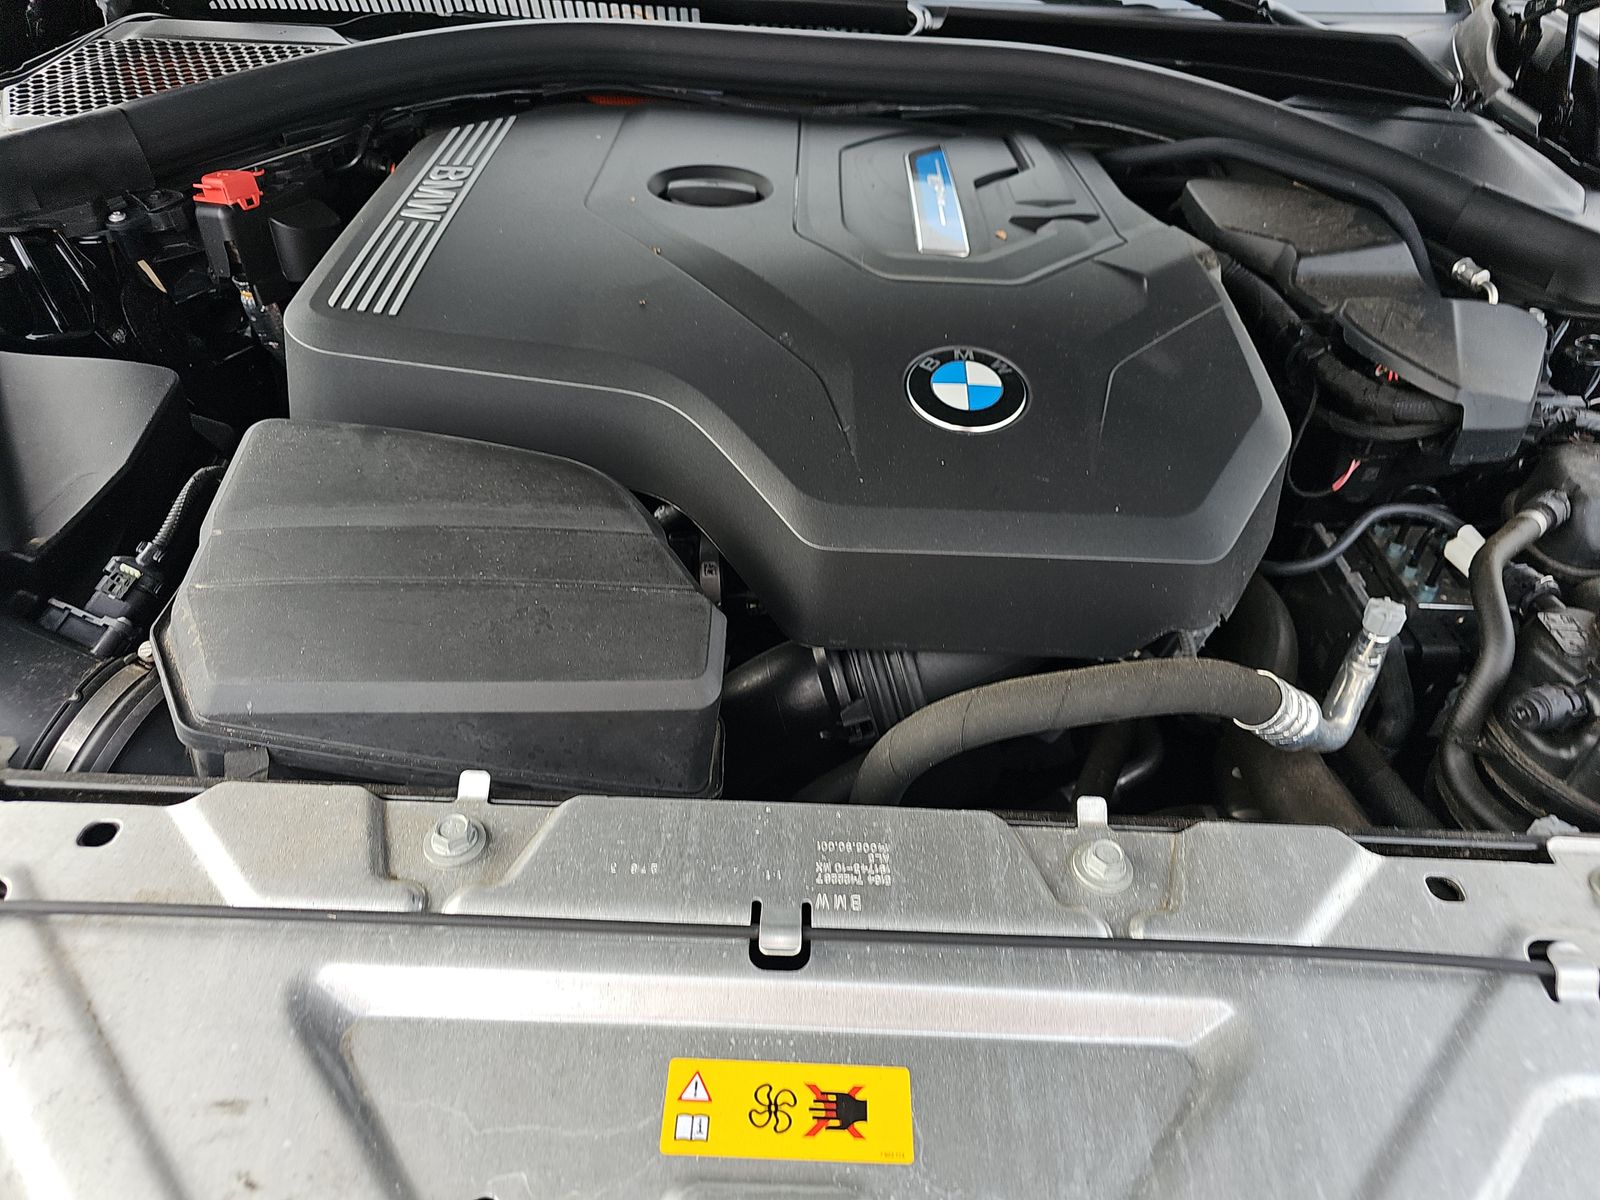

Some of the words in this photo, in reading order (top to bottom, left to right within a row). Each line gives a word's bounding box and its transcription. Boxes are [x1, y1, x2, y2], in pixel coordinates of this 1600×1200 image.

[400, 165, 473, 221] BMW
[918, 347, 1013, 375] BMW
[815, 893, 862, 911] BMW
